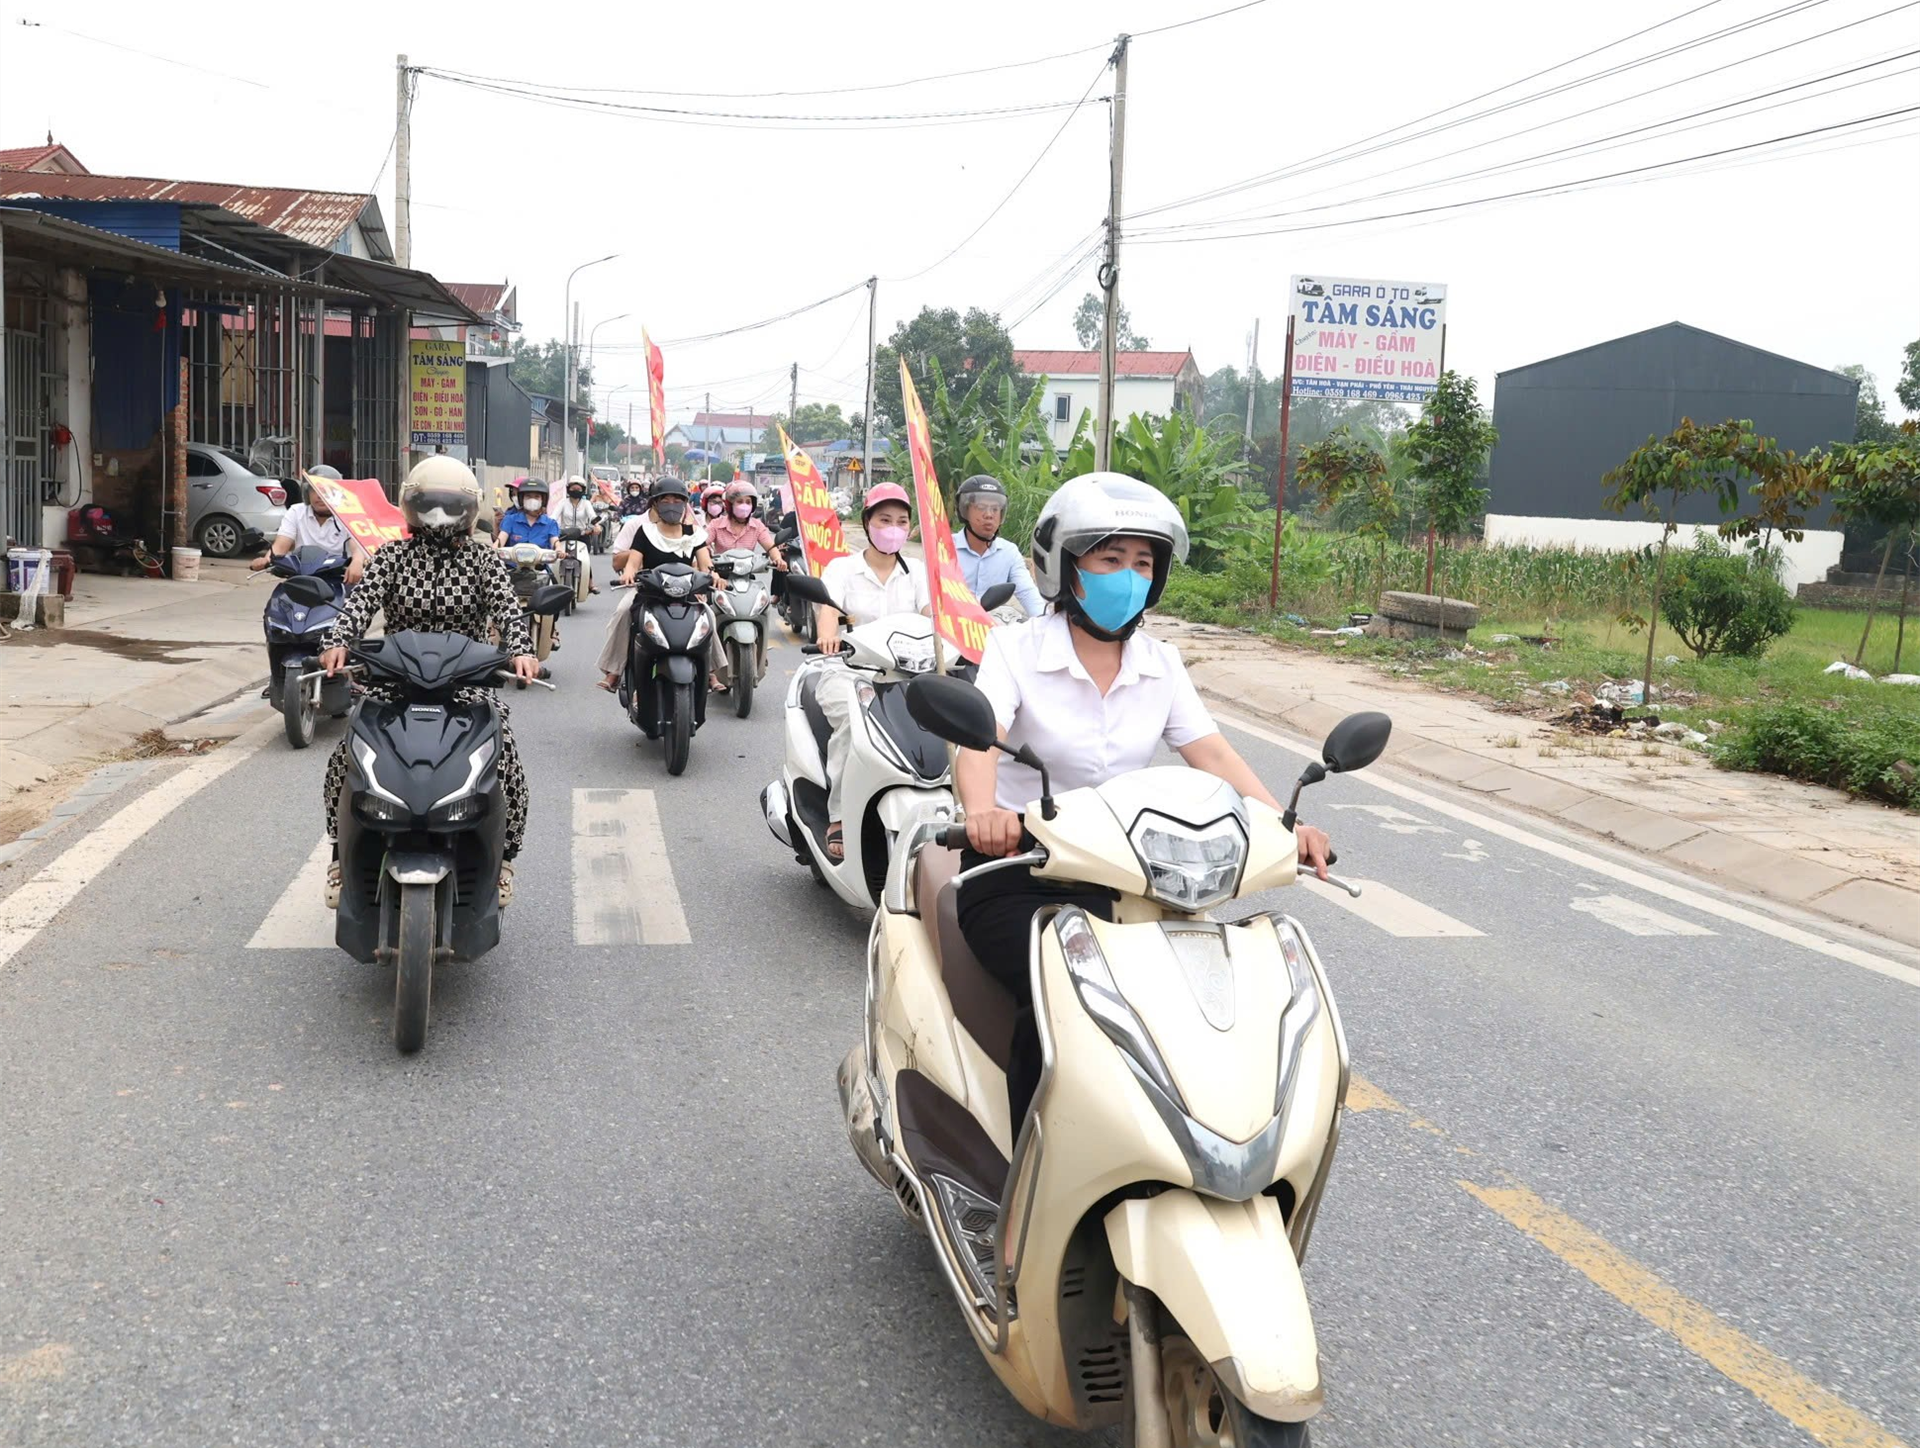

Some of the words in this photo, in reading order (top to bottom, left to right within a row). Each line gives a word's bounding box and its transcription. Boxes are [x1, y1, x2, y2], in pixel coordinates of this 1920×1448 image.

[1332, 284, 1371, 298] GARA
[1302, 295, 1359, 326] TÂM
[1365, 299, 1437, 330] SÁNG
[425, 342, 451, 351] GARA
[1318, 329, 1358, 349] MÁY
[1375, 330, 1416, 353] GẦM
[413, 351, 434, 366] TÂM
[436, 352, 464, 367] SÁNG
[1295, 352, 1337, 375] ĐIỆN
[1355, 354, 1396, 375] ĐIỀU
[1401, 358, 1436, 378] HOÀ
[1292, 386, 1323, 396] Hotline:
[1346, 389, 1360, 398] 168
[1362, 390, 1378, 399] 469
[1406, 392, 1421, 401] 423
[1115, 510, 1160, 519] HONDA
